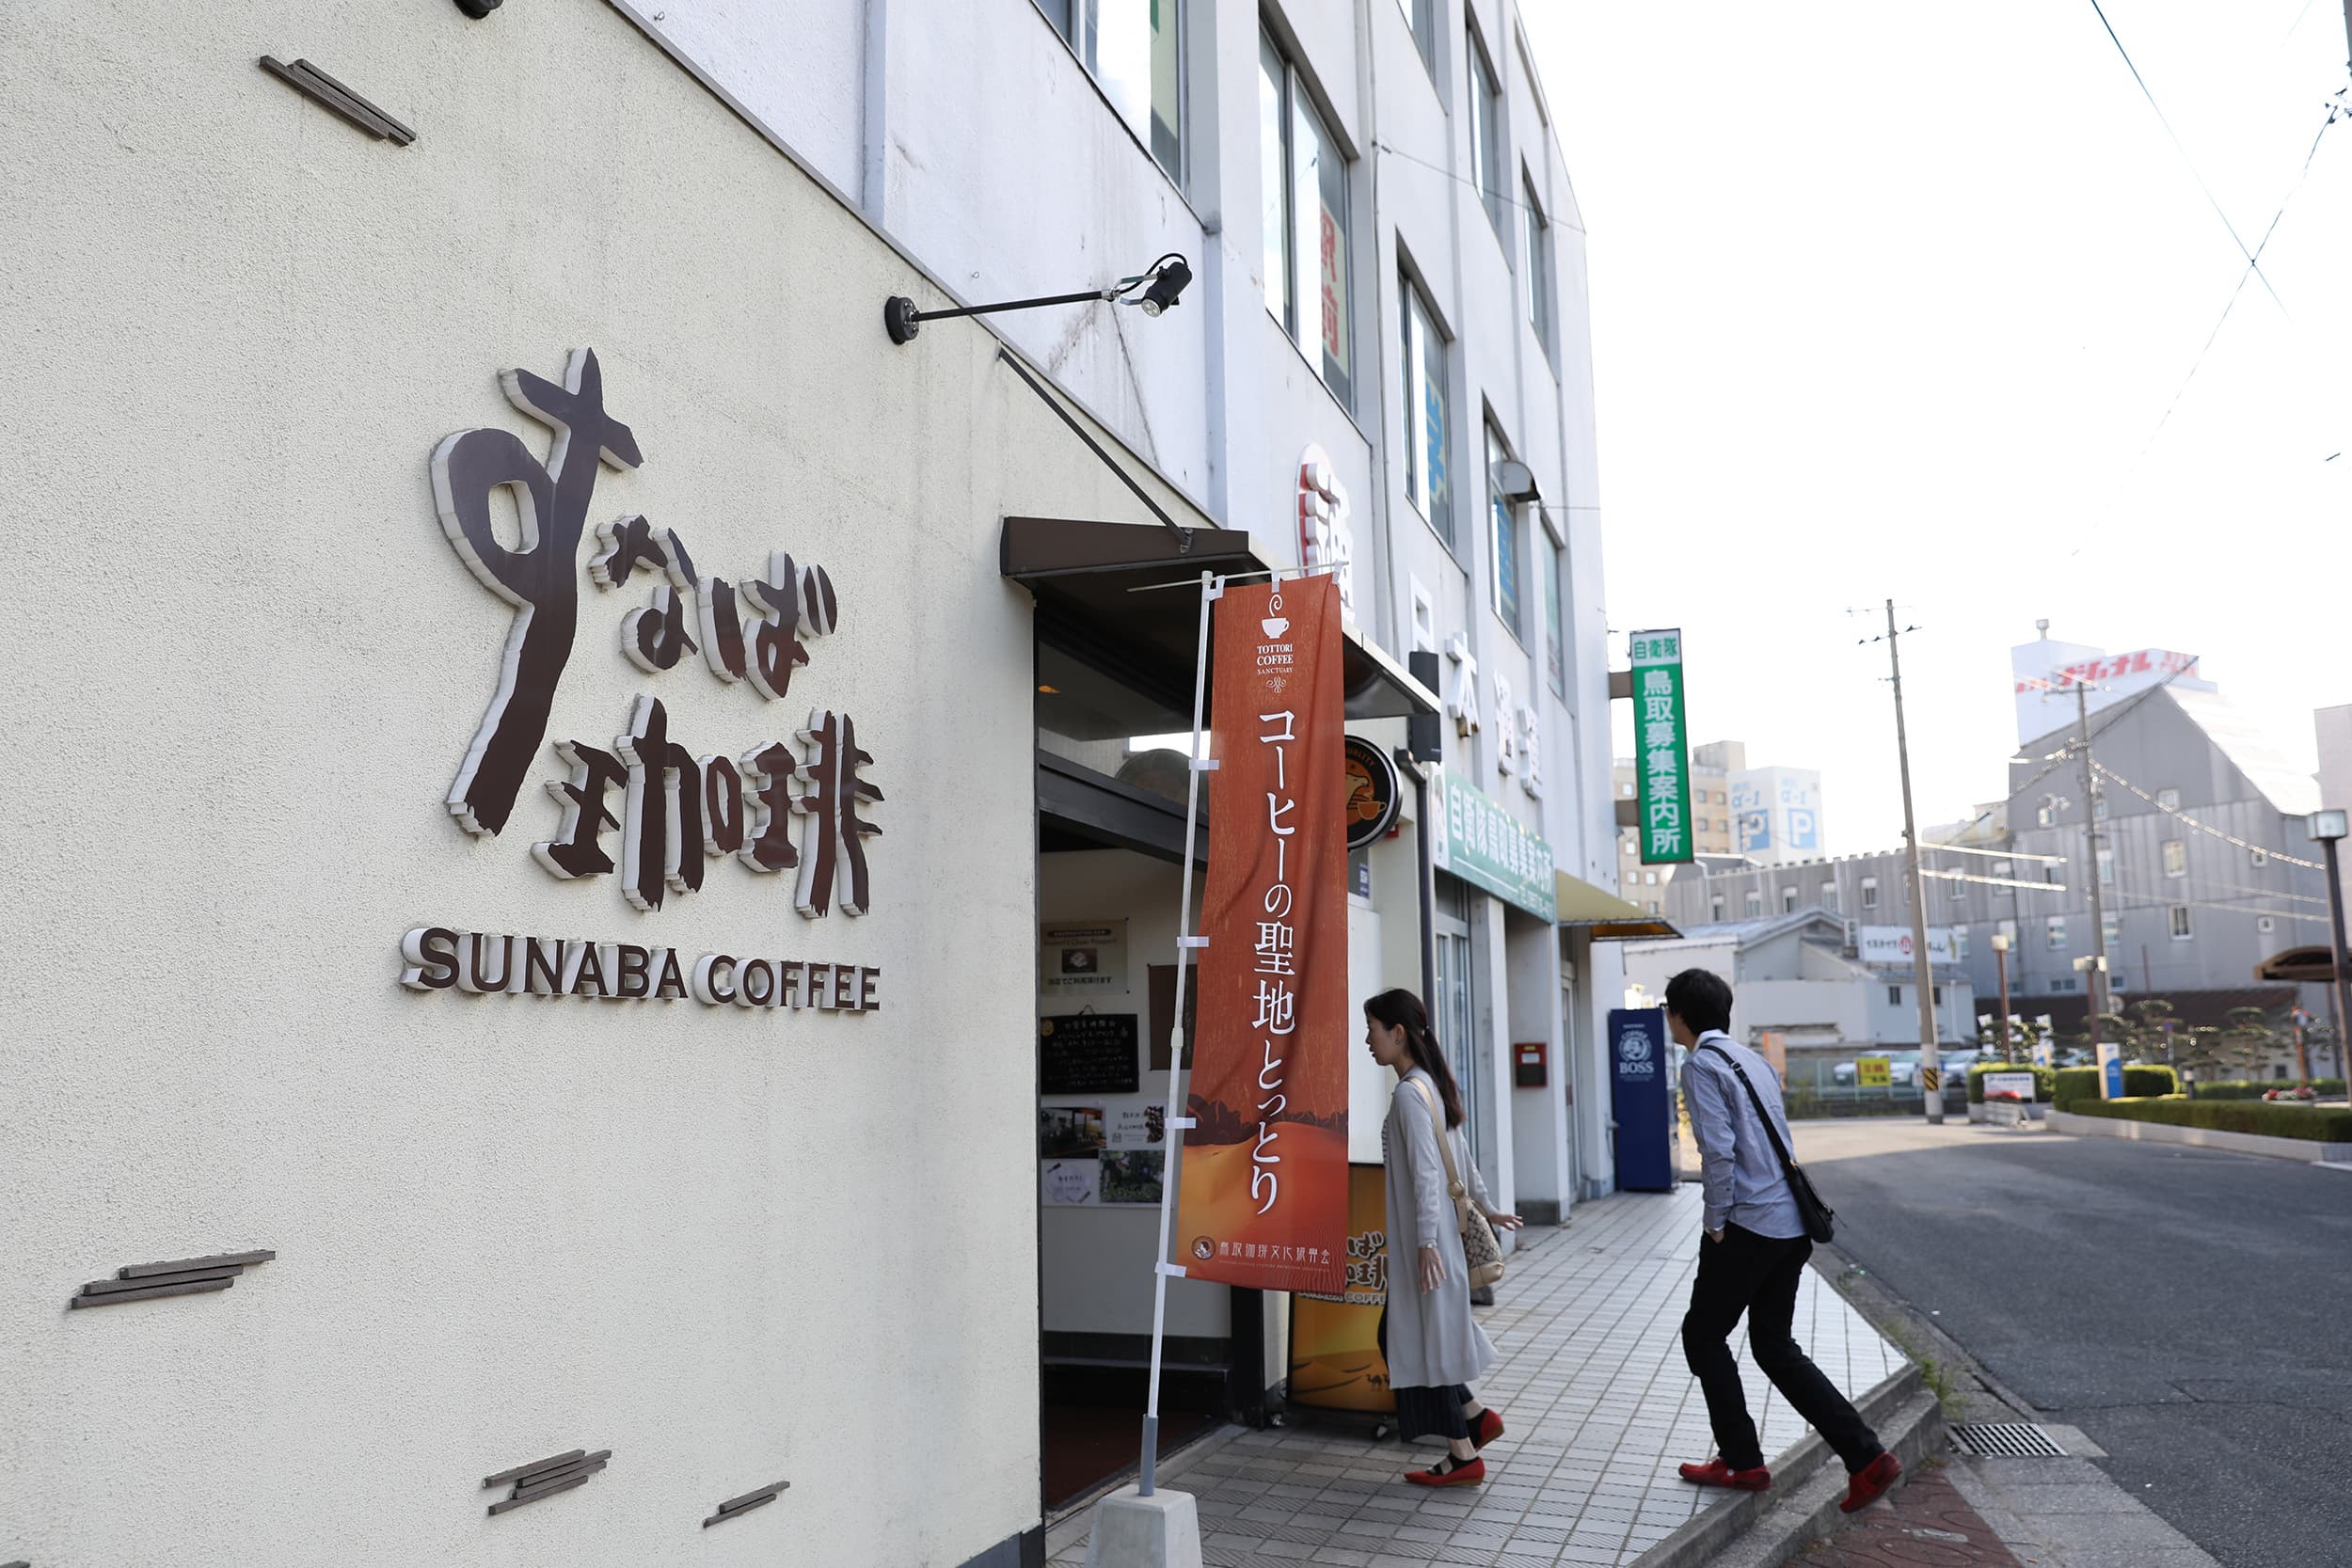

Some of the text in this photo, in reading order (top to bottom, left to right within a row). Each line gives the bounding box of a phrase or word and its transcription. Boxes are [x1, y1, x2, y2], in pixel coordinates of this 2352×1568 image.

[1257, 643, 1293, 654] TOTTORI
[1633, 637, 1678, 660] 自衛隊
[1256, 655, 1294, 666] COFFEE
[1257, 667, 1294, 675] SANCTUARY
[1643, 669, 1682, 855] 鳥取募集案内所
[530, 694, 885, 920] 珈琲
[405, 927, 881, 1012] SUNABA COFFEE
[1250, 709, 1297, 1215] コーヒーの聖地とっとり
[1619, 1061, 1655, 1073] BOSS
